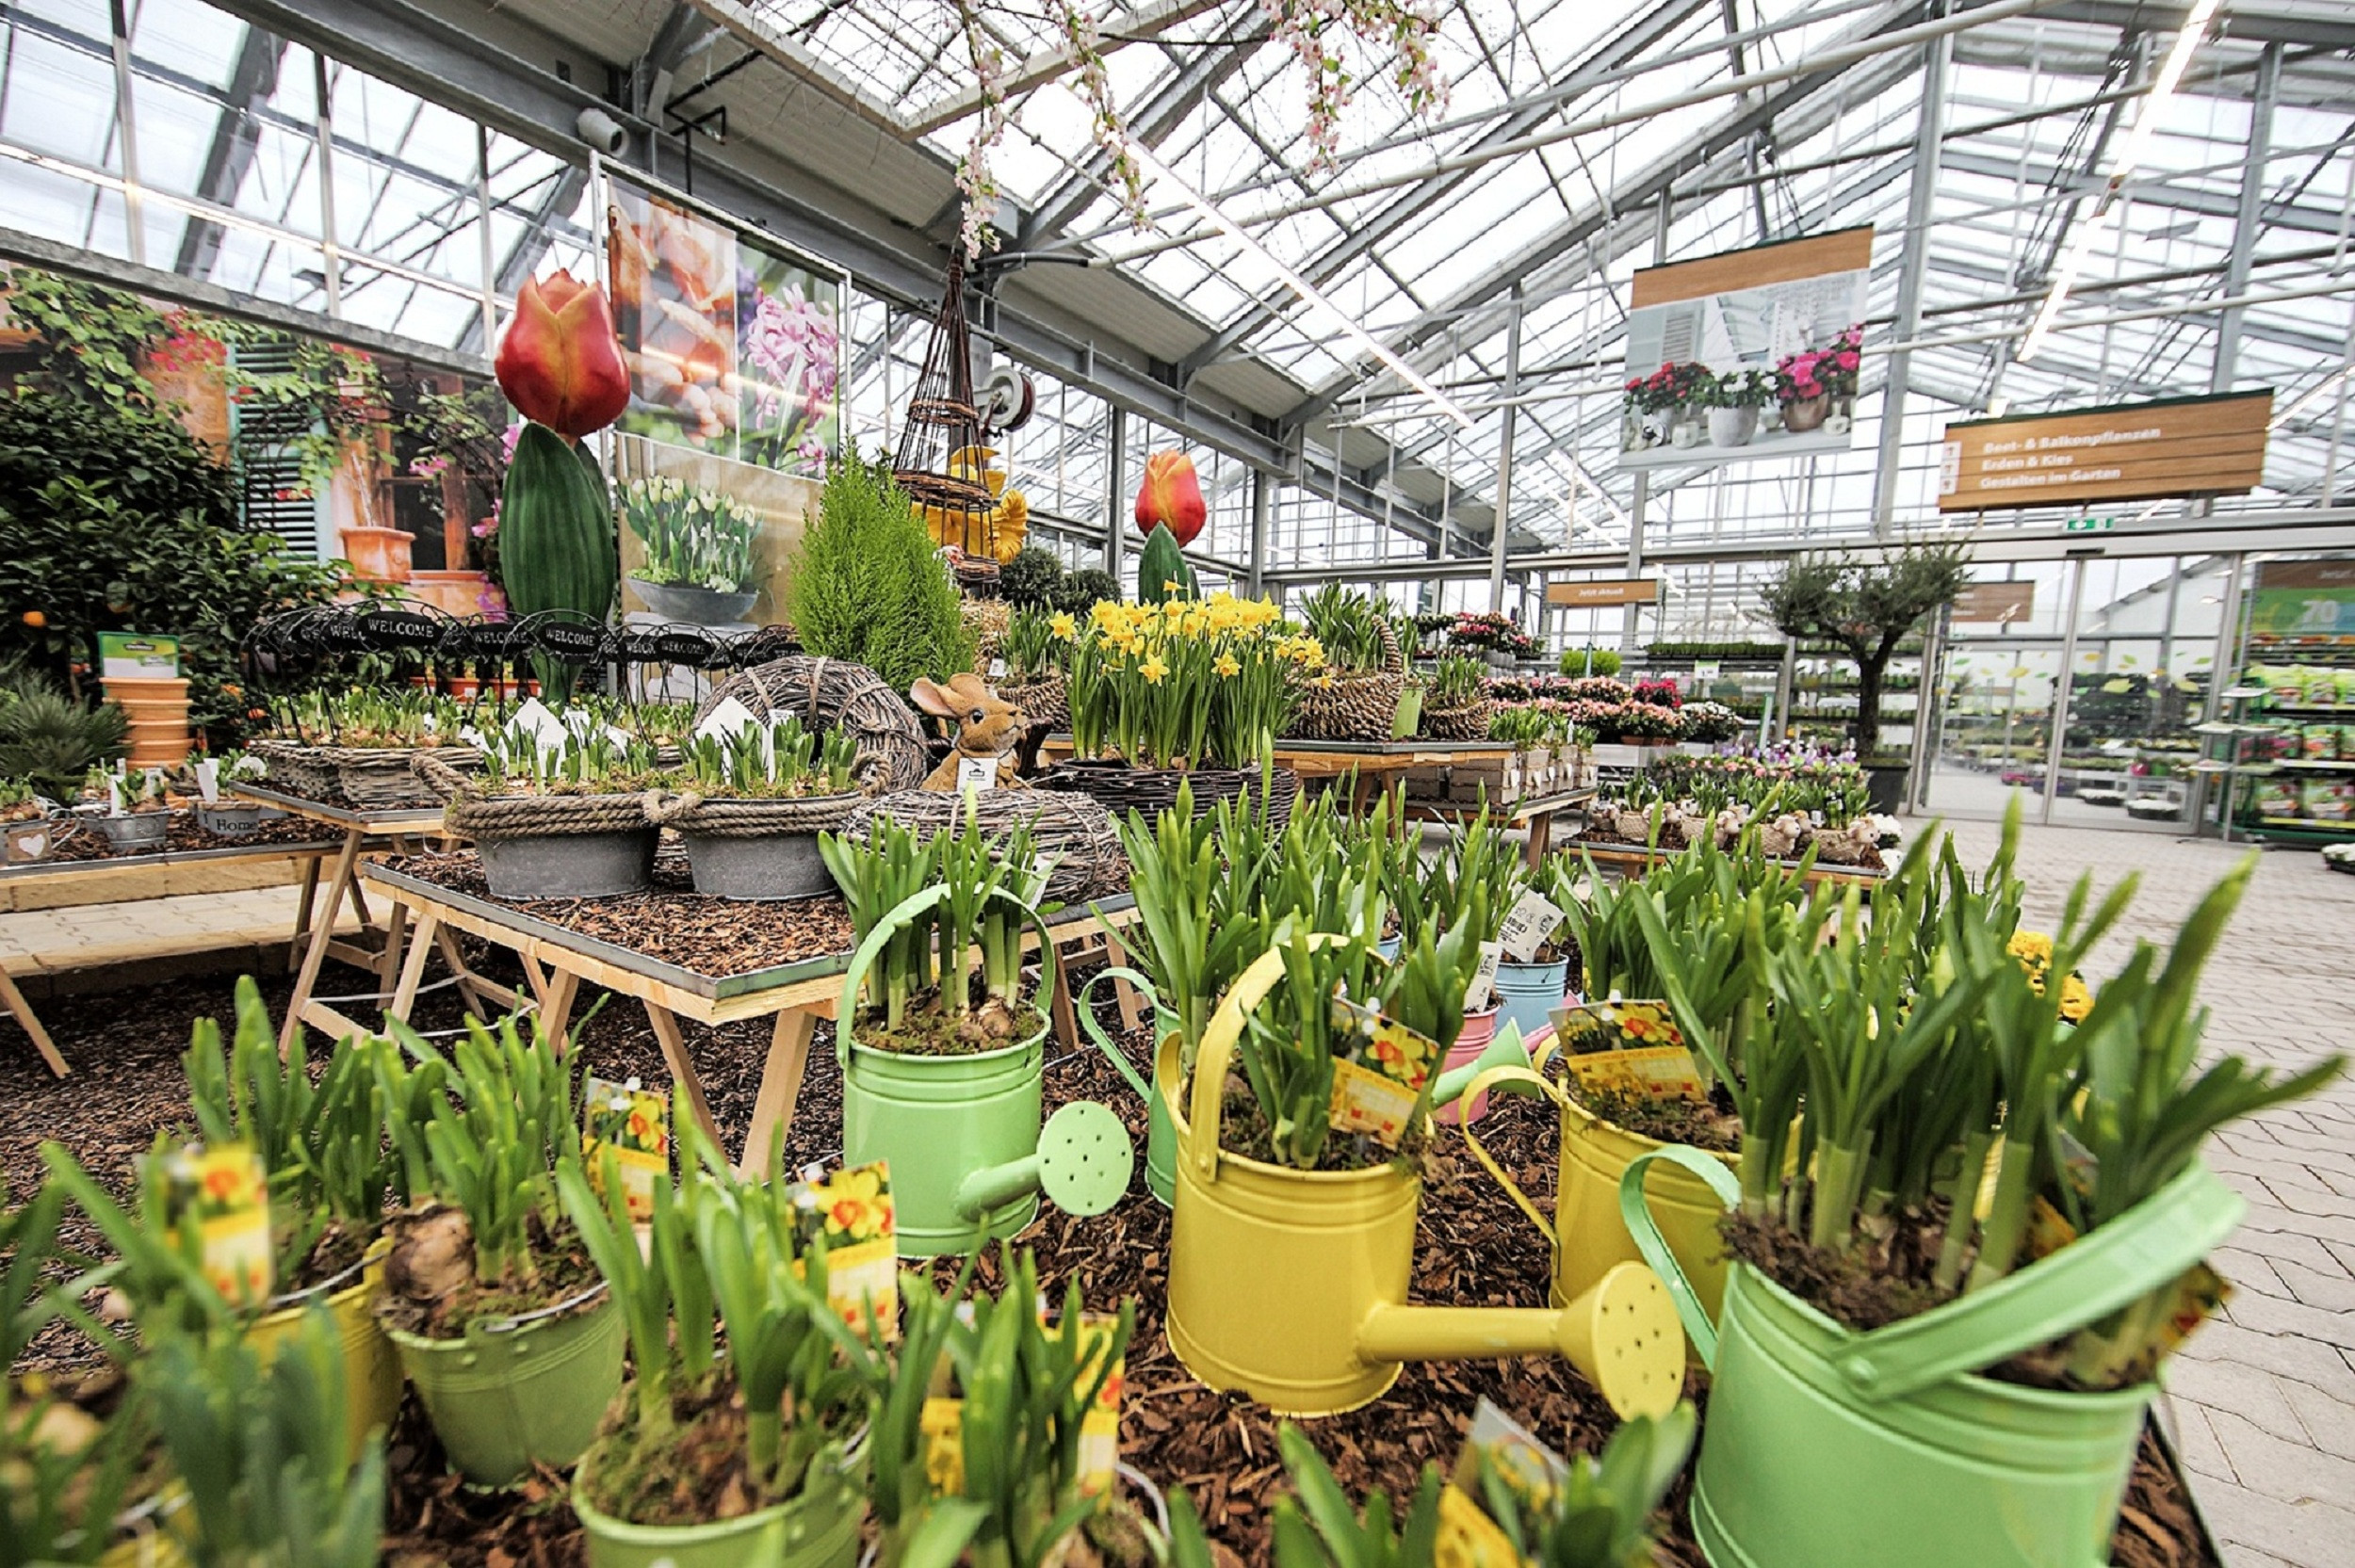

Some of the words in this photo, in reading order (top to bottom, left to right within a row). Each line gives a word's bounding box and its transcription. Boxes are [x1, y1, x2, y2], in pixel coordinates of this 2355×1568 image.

[2025, 439, 2036, 449] &
[2039, 428, 2161, 447] Balkonpflanzen
[1982, 458, 2024, 471] Erden
[2027, 456, 2038, 466] &
[2042, 454, 2073, 465] Kies
[1980, 475, 2046, 489] Gestalten
[2048, 472, 2068, 483] im
[2071, 469, 2120, 482] Garten
[2301, 600, 2339, 622] 70
[367, 619, 434, 638] WELCOME
[545, 628, 594, 646] WELCOME
[661, 639, 706, 655] WELCOME
[217, 818, 257, 832] Home
